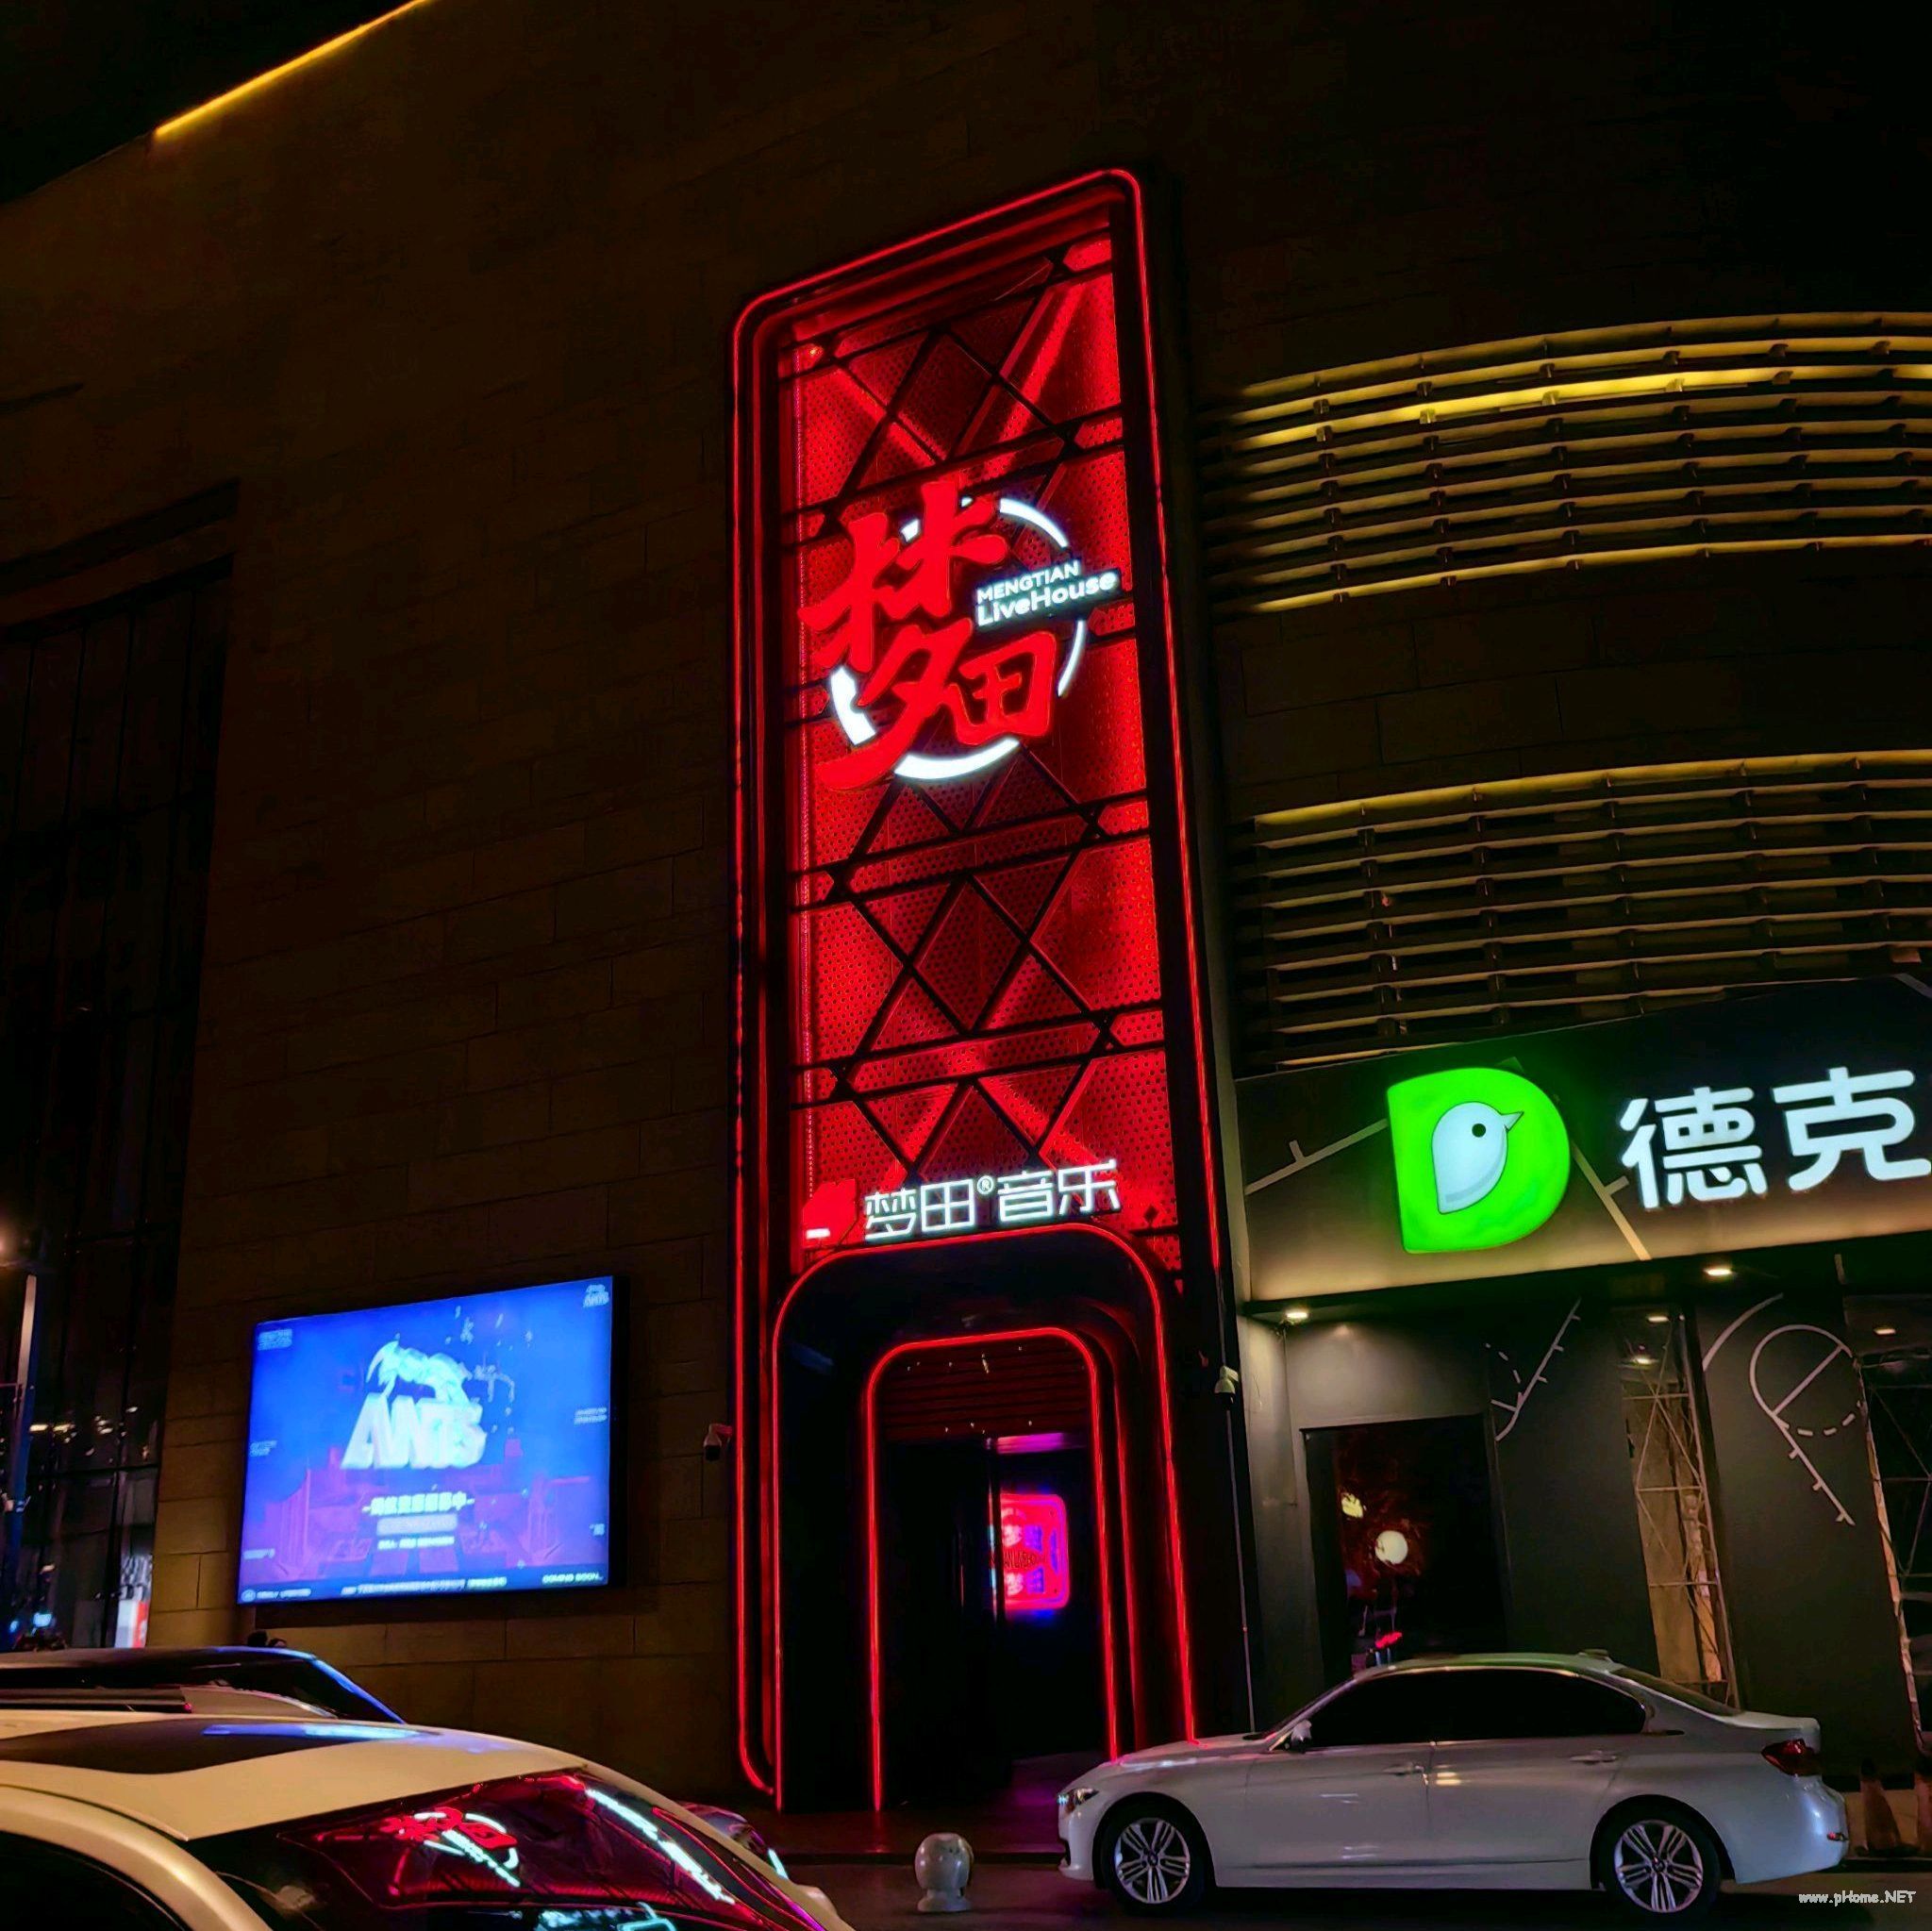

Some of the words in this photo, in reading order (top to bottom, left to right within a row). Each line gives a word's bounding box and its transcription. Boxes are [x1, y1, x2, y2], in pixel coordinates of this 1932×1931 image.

[976, 560, 1081, 604] MENGTIAN
[977, 572, 1118, 626] LiveHouse
[1620, 1067, 1932, 1210] 德克
